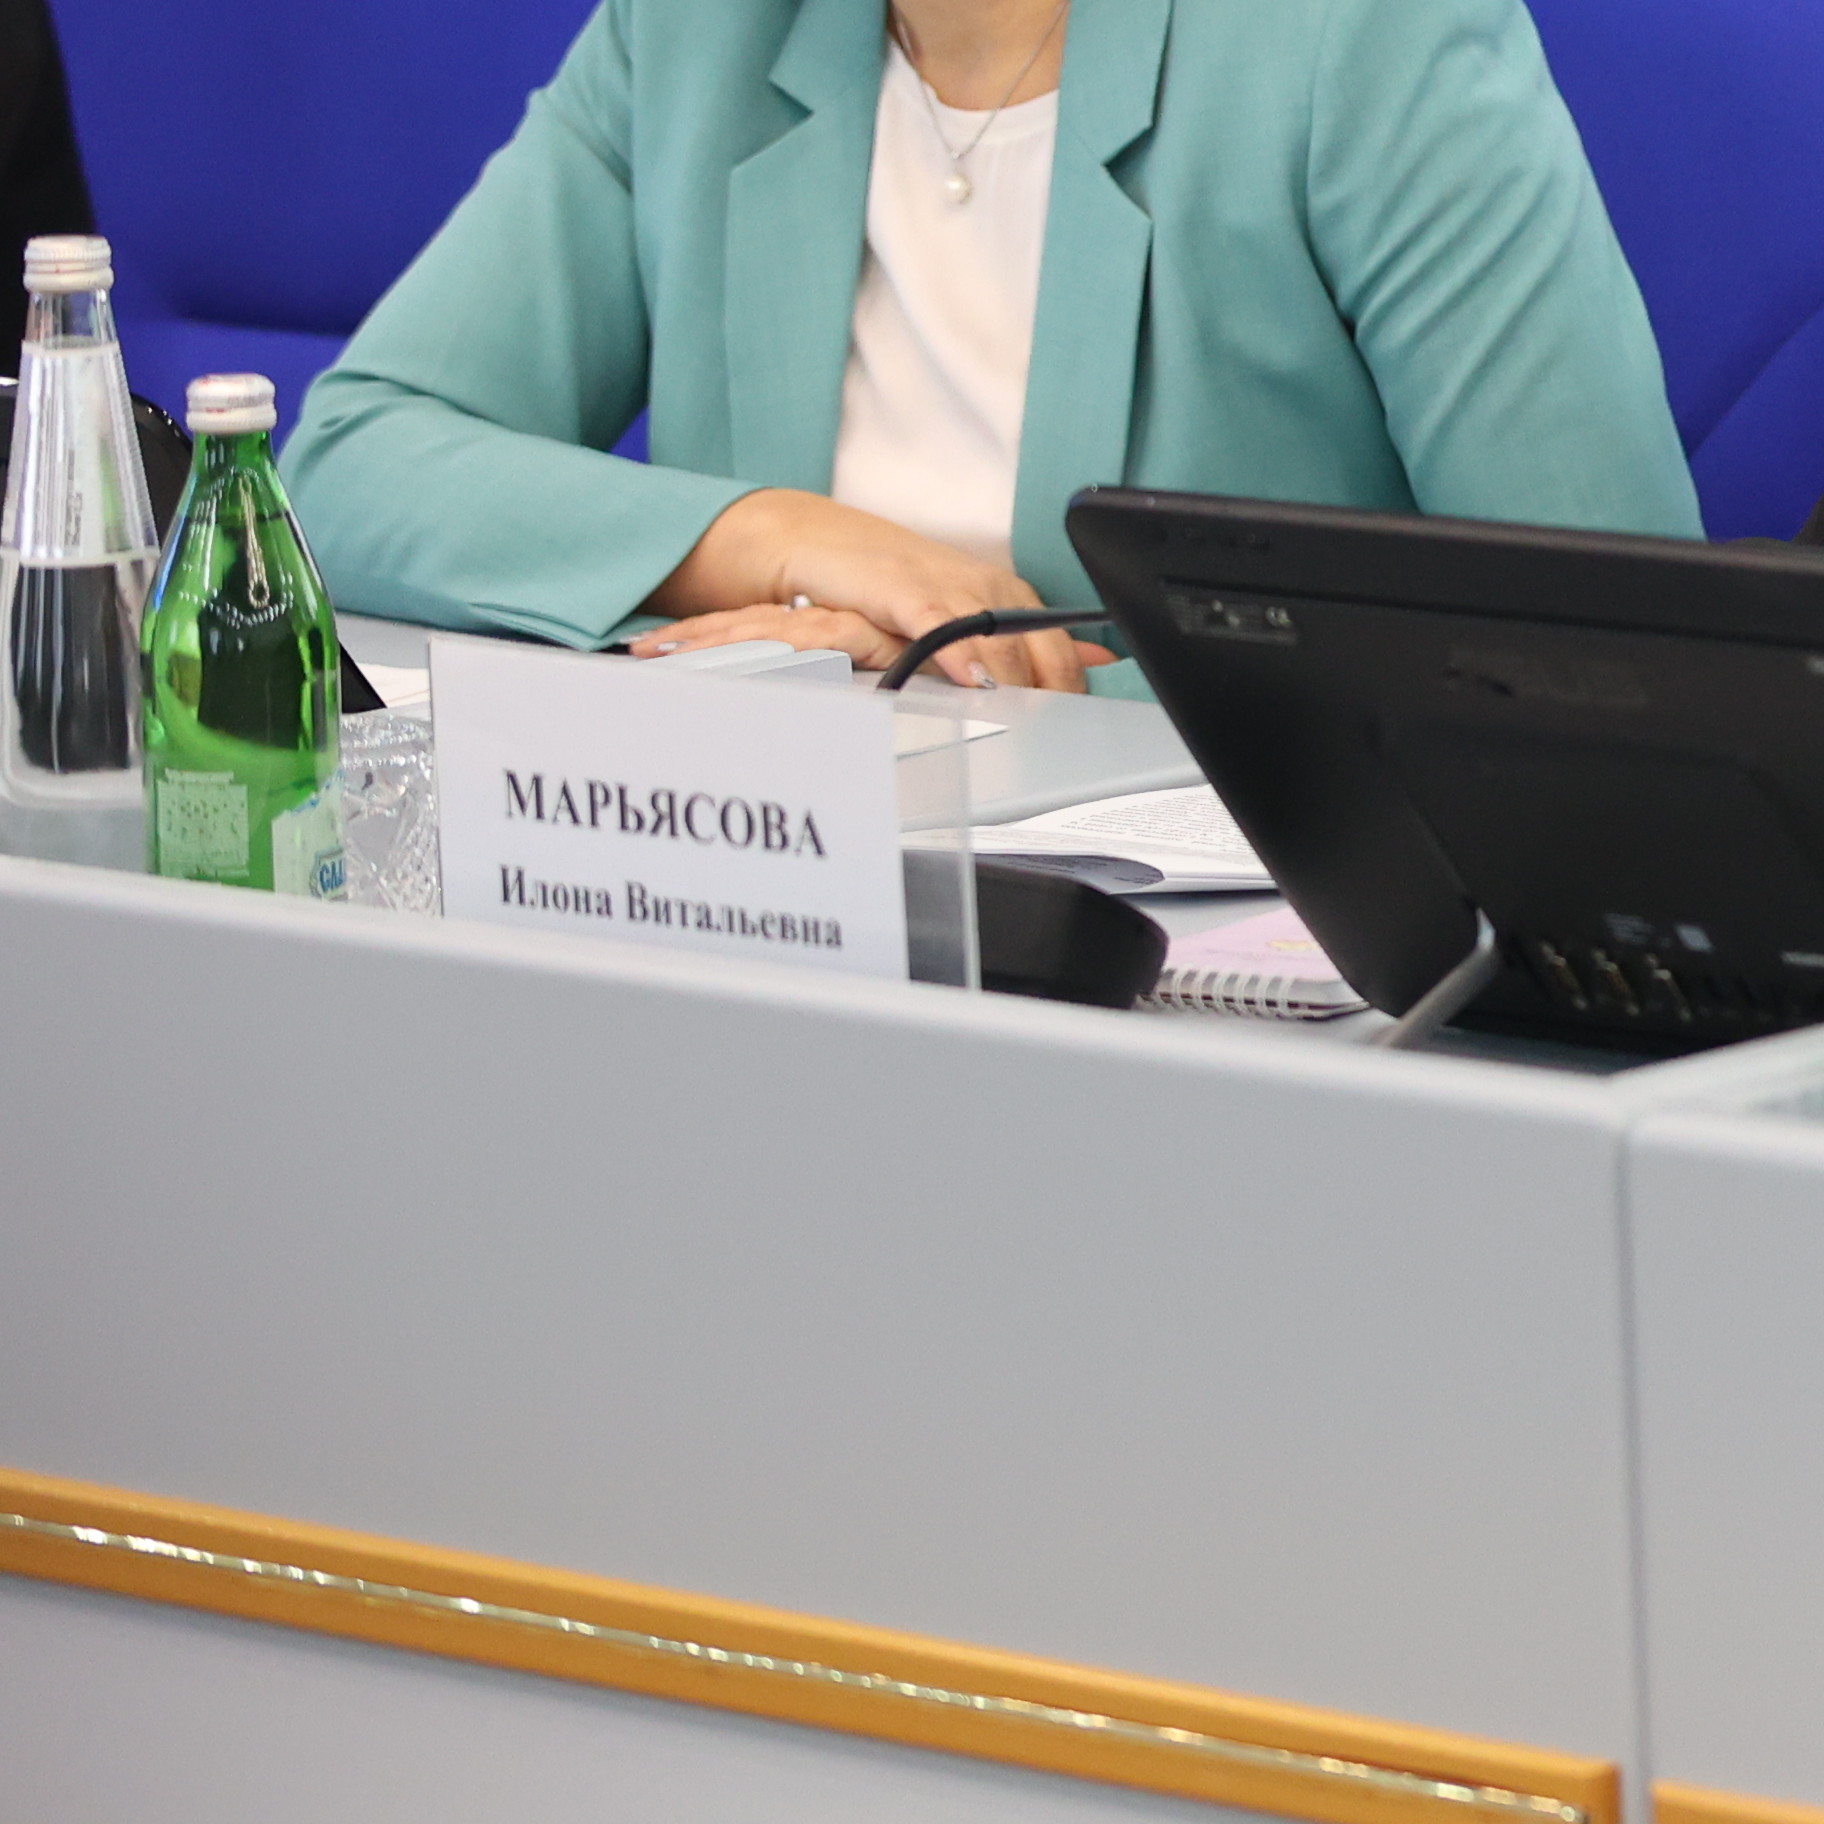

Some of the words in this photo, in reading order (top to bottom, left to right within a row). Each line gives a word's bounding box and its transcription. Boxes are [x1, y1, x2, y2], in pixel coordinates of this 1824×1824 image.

[502, 768, 827, 858] МАРЬЯСОВА
[499, 863, 613, 919] Илона
[626, 880, 843, 950] Витальевна
